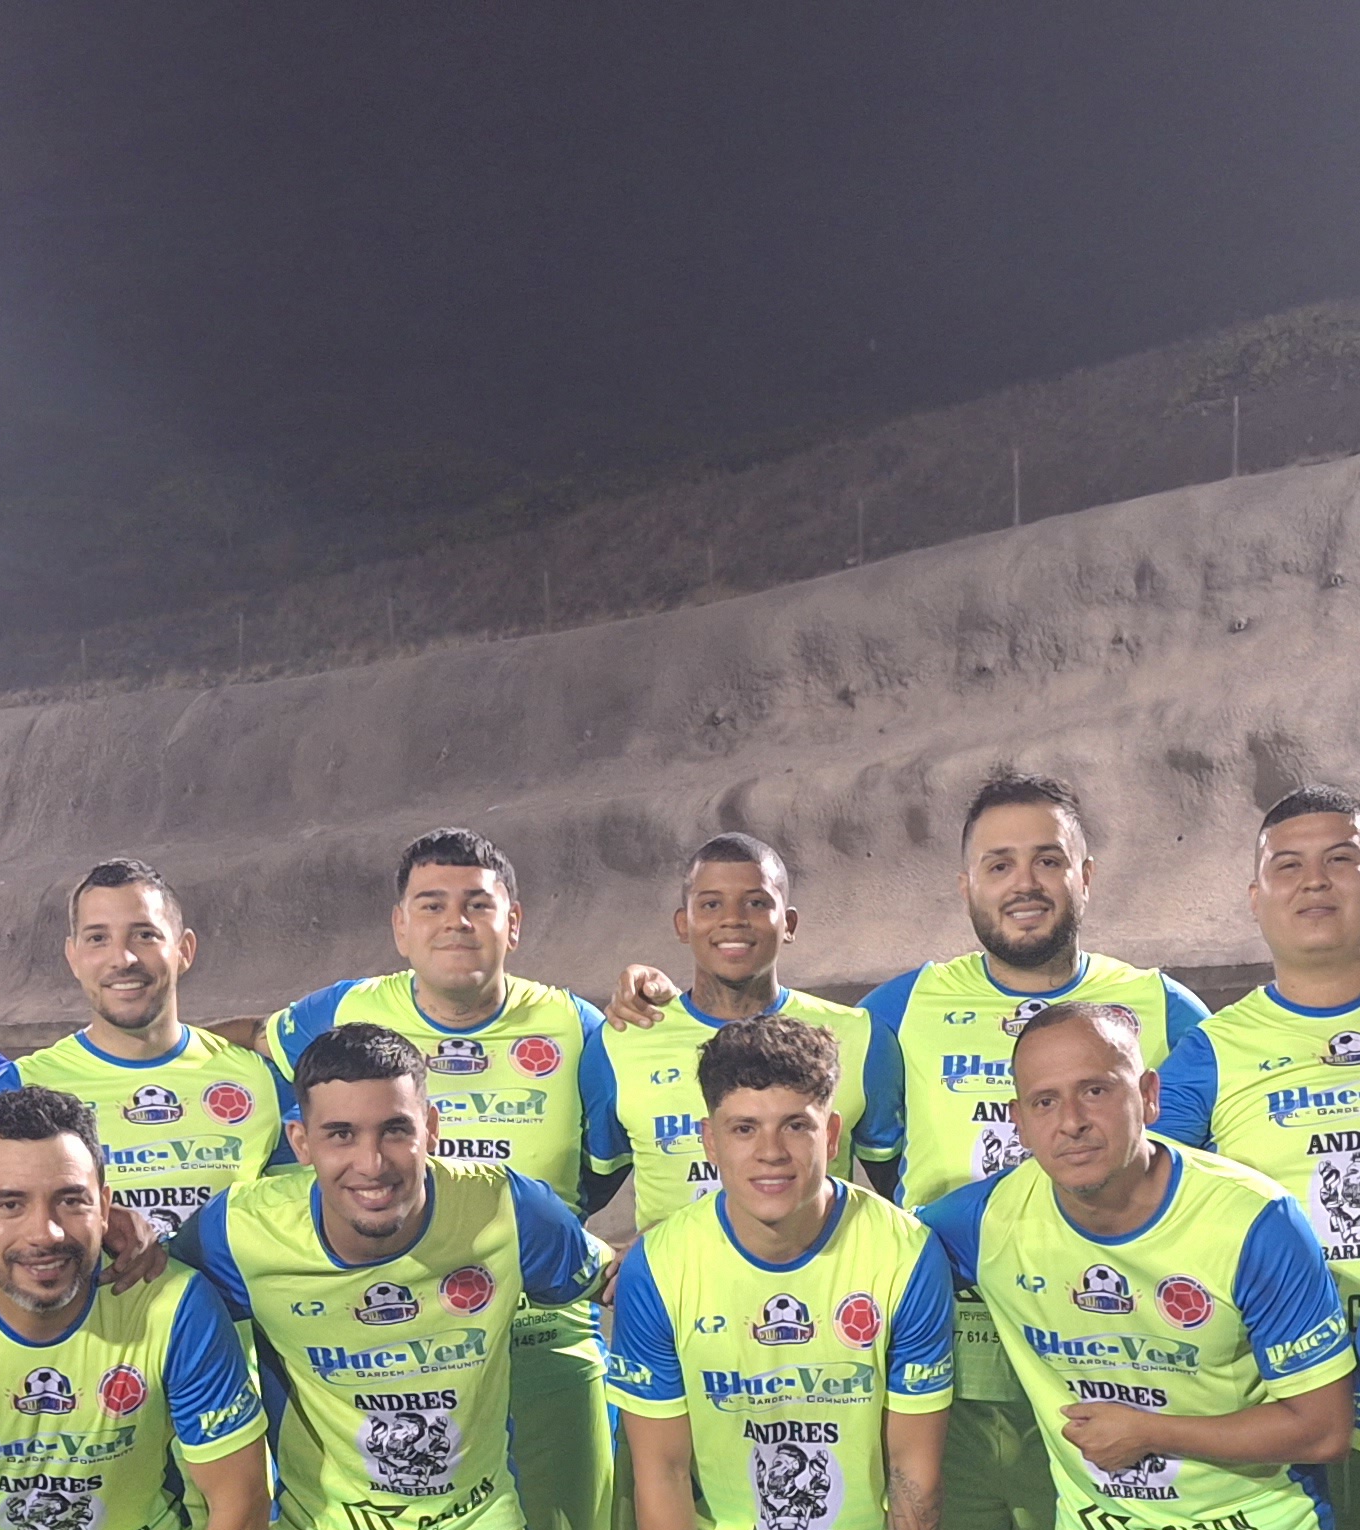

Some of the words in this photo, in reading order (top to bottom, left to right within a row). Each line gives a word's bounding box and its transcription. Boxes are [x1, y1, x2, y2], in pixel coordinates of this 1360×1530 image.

[104, 1136, 242, 1165] lue-Vert
[111, 1187, 211, 1208] ANDRES
[513, 1311, 558, 1328] achadas
[305, 1328, 487, 1370] Blue-Vert
[967, 1331, 988, 1343] 614
[1022, 1324, 1200, 1367] Blue-Vert
[701, 1362, 874, 1395] Blue-Vert
[355, 1390, 457, 1410] ANDRES
[743, 1420, 839, 1444] ANDRES
